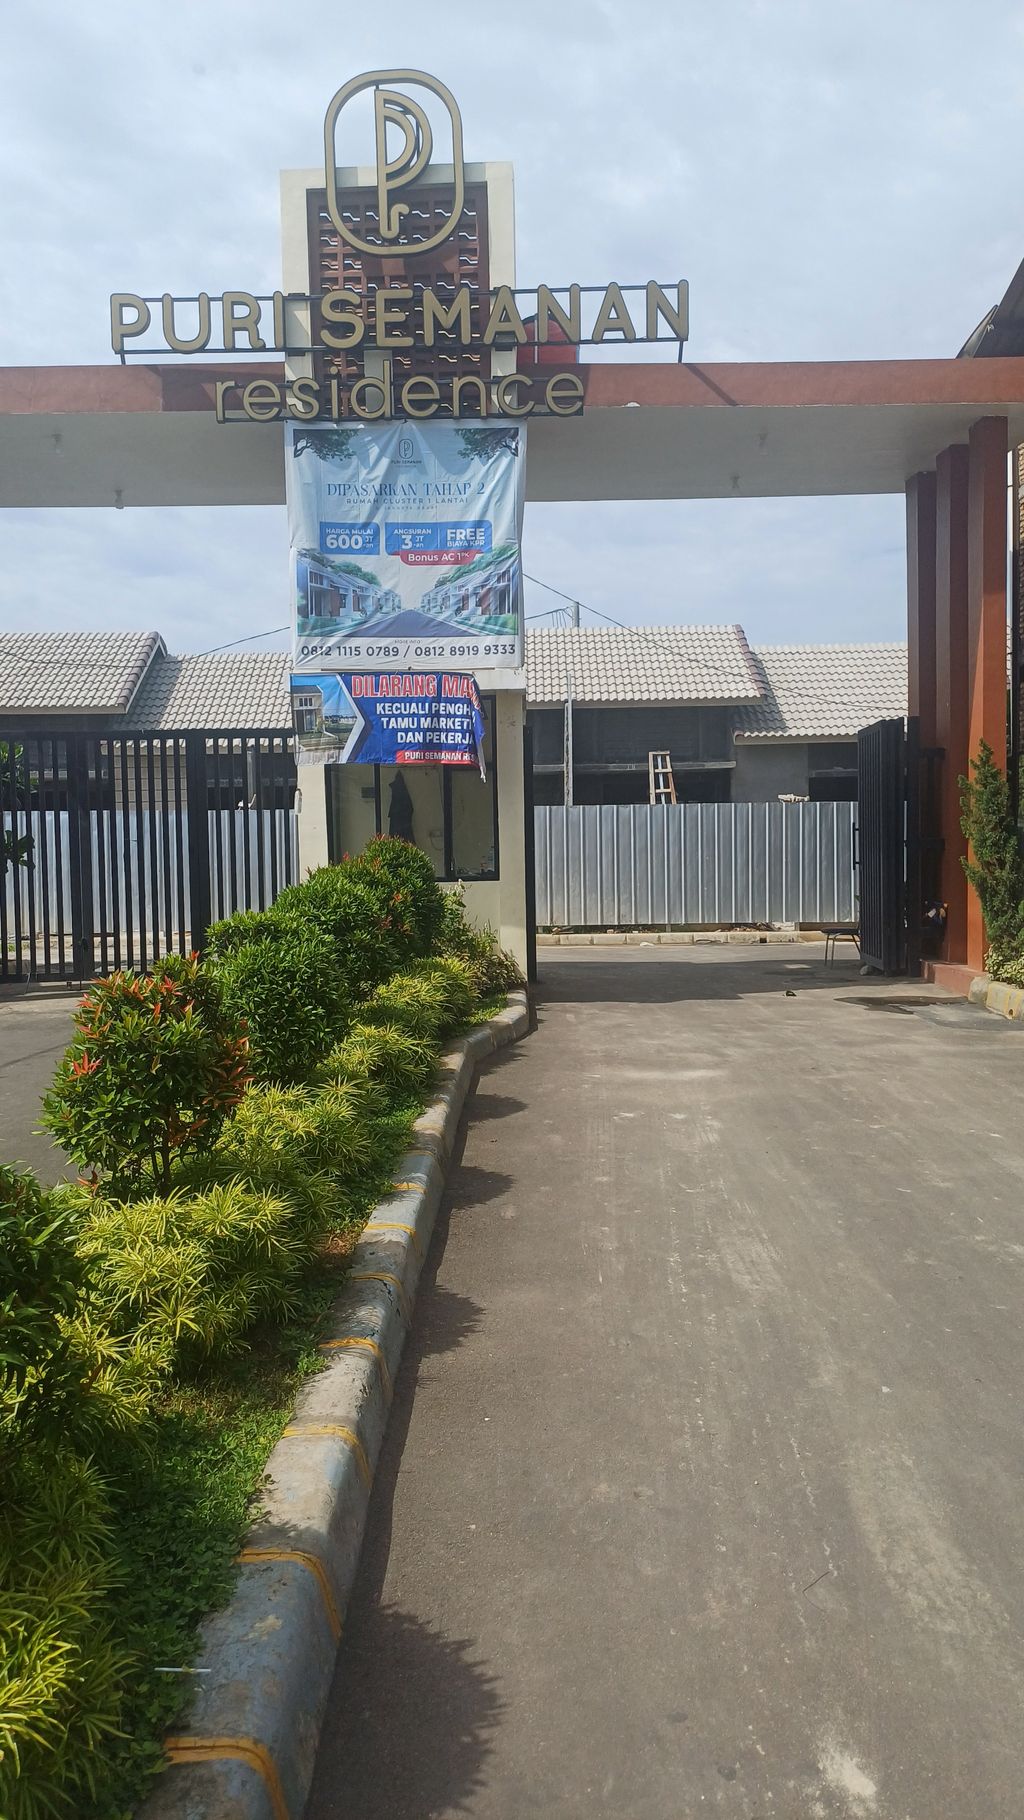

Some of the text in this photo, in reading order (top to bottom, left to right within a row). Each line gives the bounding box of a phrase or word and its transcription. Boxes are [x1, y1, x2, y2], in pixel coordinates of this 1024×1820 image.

[110, 278, 690, 353] PURI SEMANAN
[215, 358, 585, 423] residence
[327, 482, 486, 496] DIPASARKAN TAHAP 2
[447, 528, 485, 540] FREE
[326, 534, 363, 550] 600
[402, 535, 413, 549] 3
[408, 553, 438, 562] Bonus
[441, 552, 454, 560] AC
[302, 644, 516, 658] 0812 1115 0789 / 0812 8919 9333
[352, 674, 437, 698] DILARANG
[376, 702, 472, 716] KECUALI PENGH
[381, 718, 418, 729] TAMU
[397, 732, 424, 744] DAN
[405, 752, 424, 760] PURI
[425, 752, 462, 760] SEMANAN
